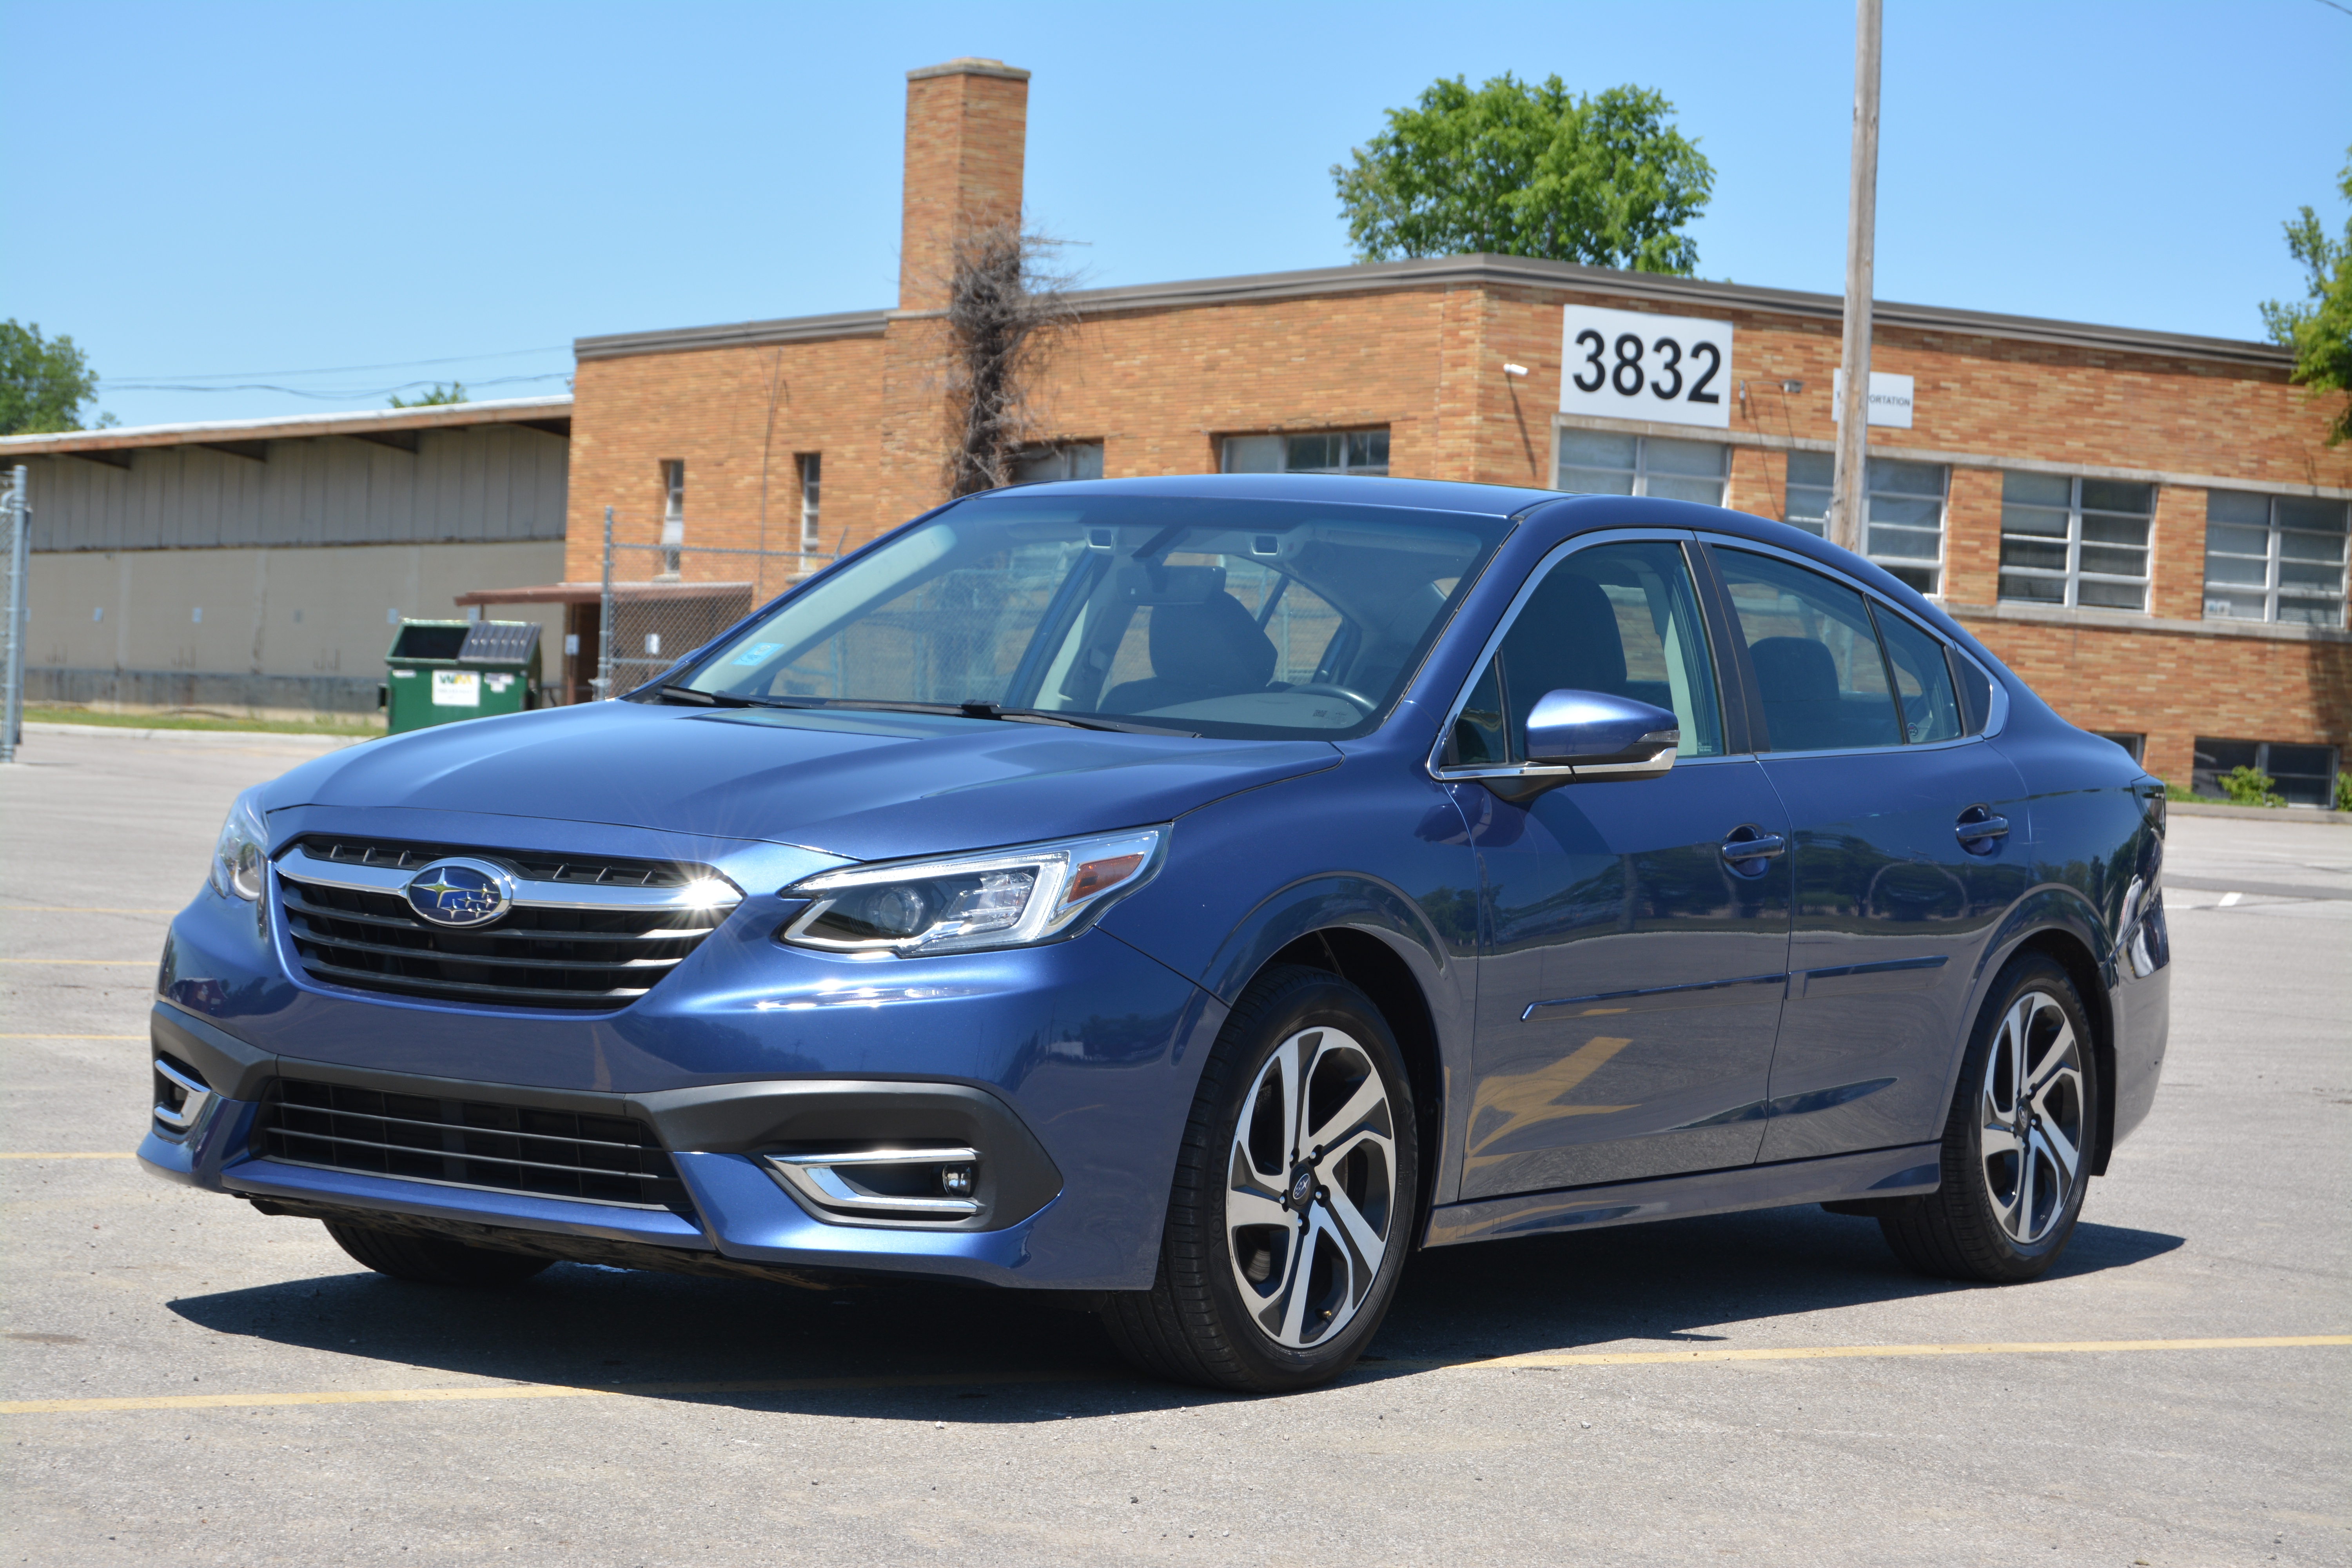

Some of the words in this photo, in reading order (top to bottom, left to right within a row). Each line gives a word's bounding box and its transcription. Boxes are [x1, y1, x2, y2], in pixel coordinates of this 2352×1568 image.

[1573, 328, 1720, 404] 3832
[1210, 1120, 1234, 1249] YOKOHAMA
[1974, 1157, 1998, 1243] YOKOHAMA
